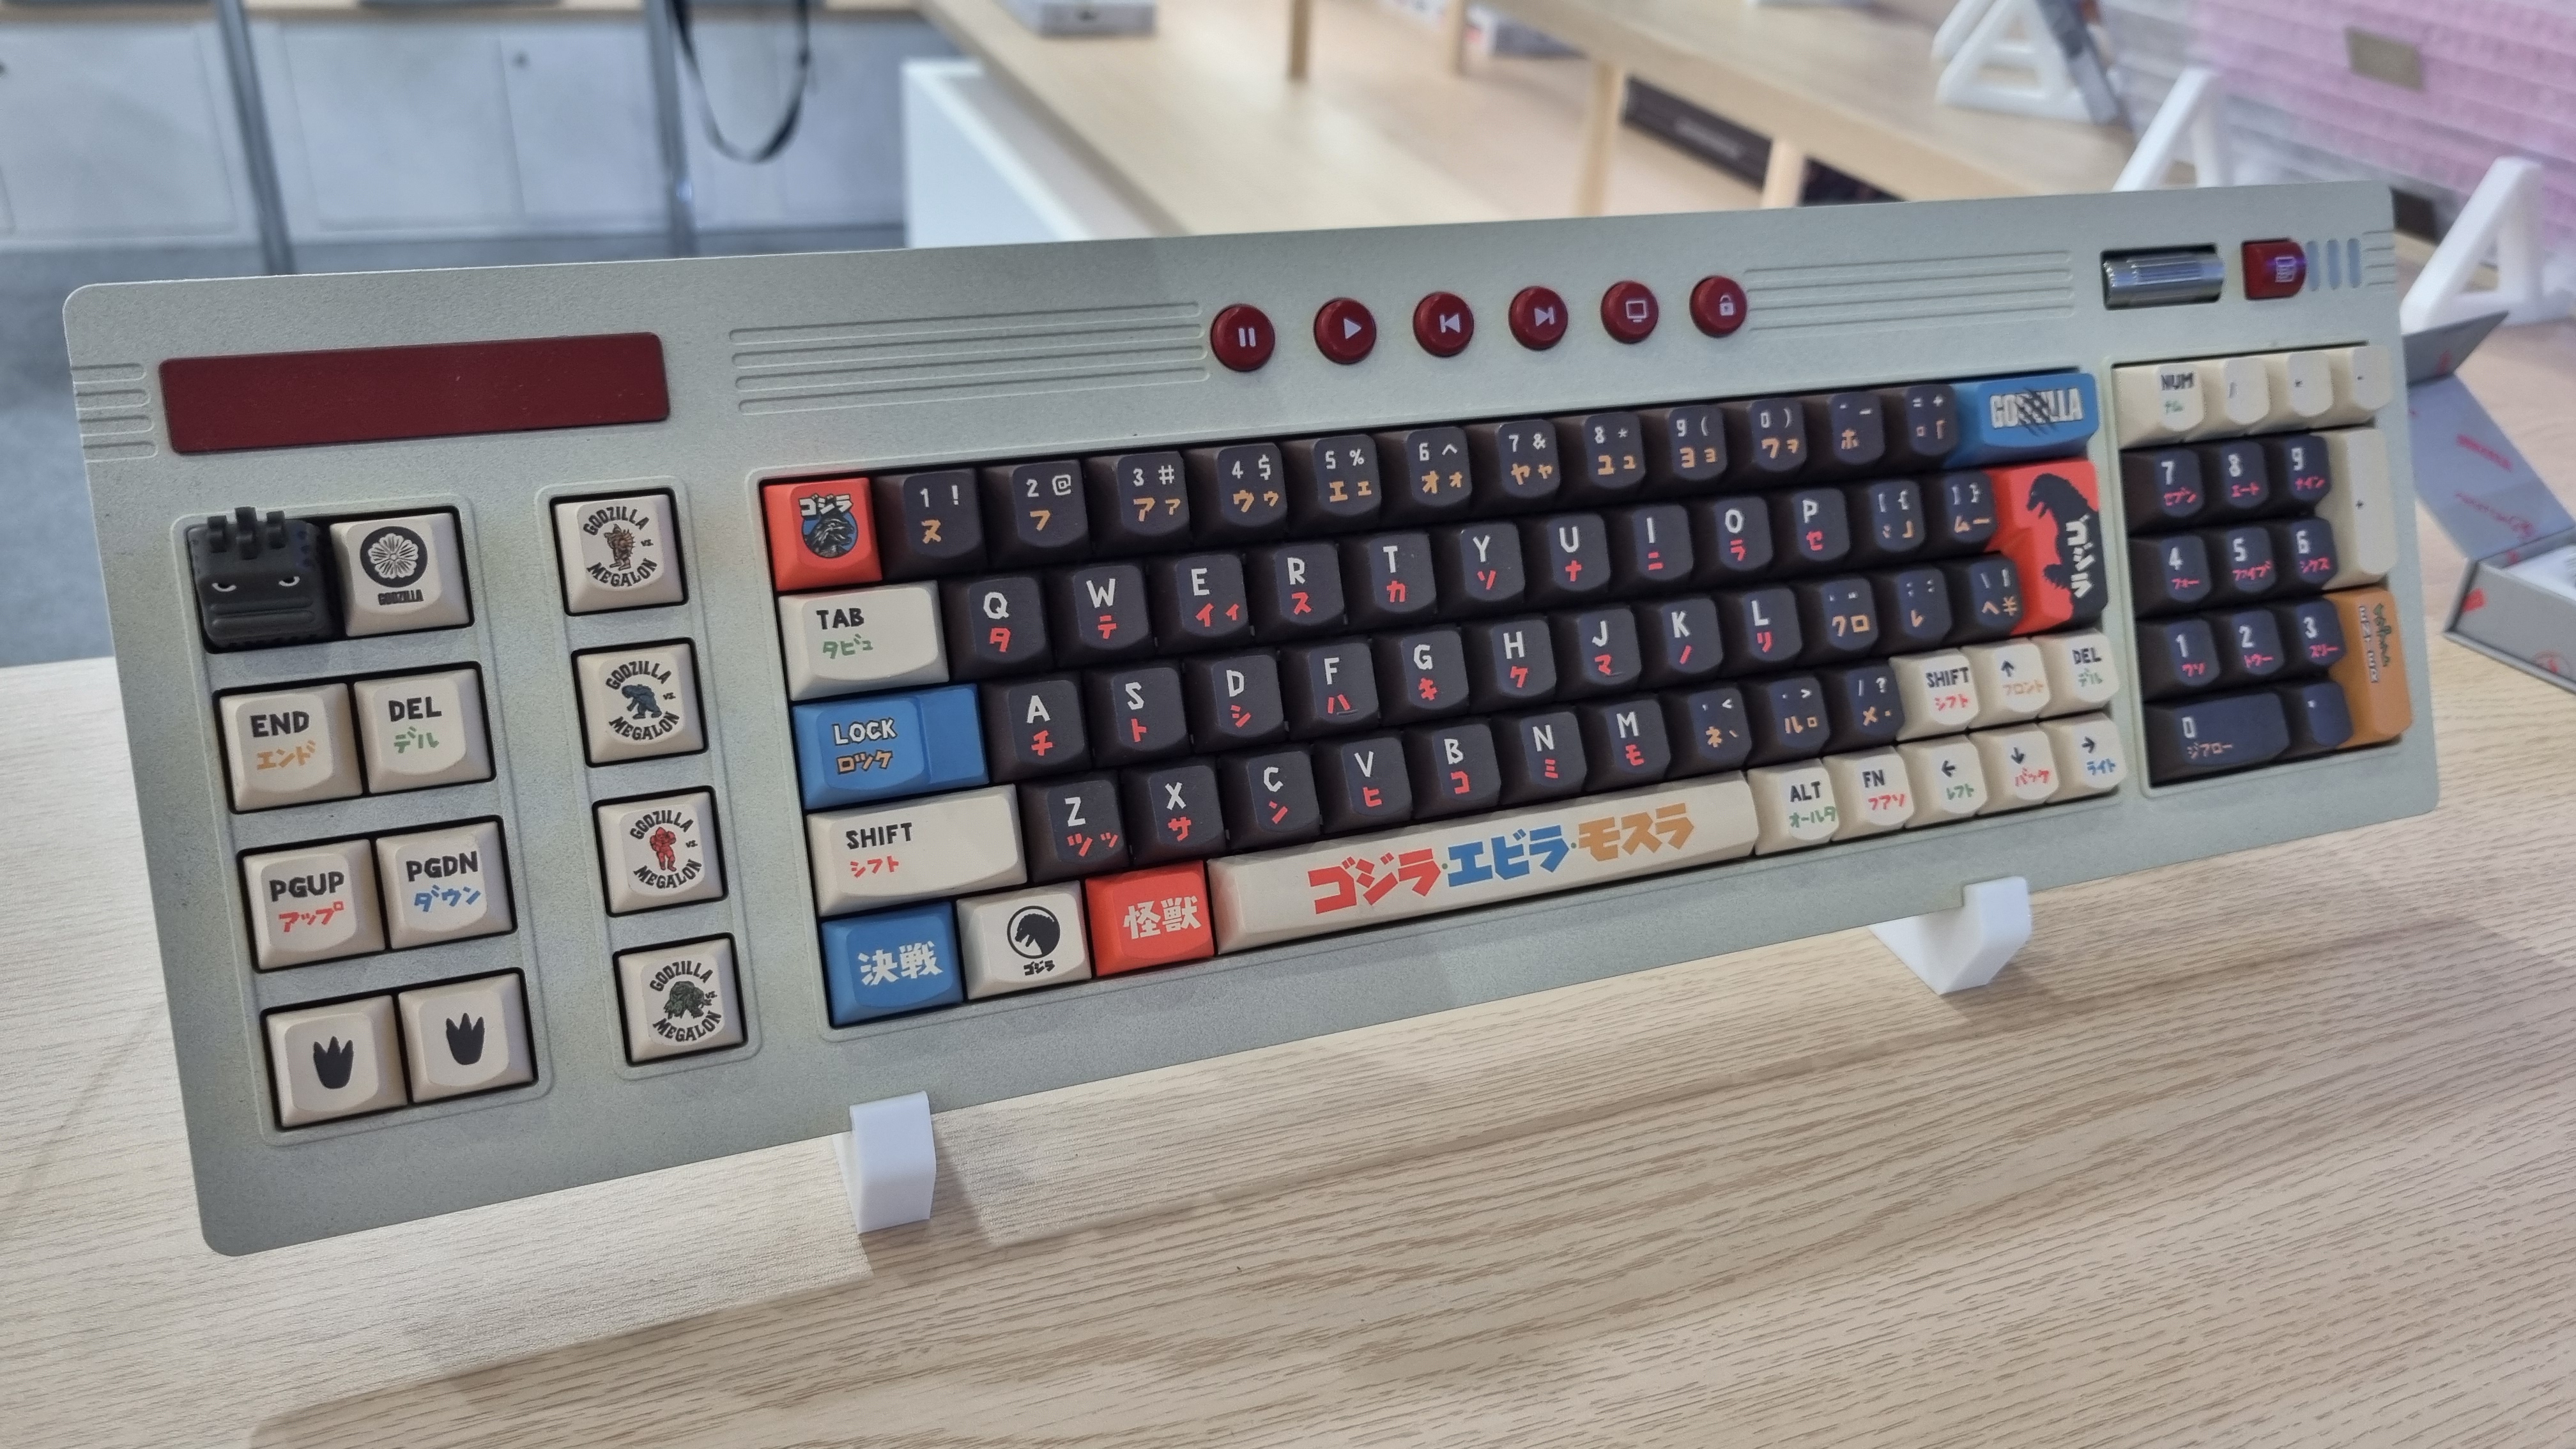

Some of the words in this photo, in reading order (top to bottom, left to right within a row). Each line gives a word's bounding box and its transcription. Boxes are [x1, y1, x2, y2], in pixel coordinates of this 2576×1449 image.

[2161, 372, 2195, 391] NUM
[1595, 426, 1605, 444] 8
[1676, 419, 1687, 437] 9
[1418, 443, 1429, 462] 6
[1508, 435, 1519, 452] 7
[1533, 433, 1546, 450] &
[1232, 461, 1243, 479] 4
[1258, 454, 1271, 480] $
[1325, 451, 1336, 470] 5
[1349, 448, 1365, 466] %
[2228, 453, 2242, 477] 8
[2291, 447, 2304, 471] 9
[1026, 479, 1039, 498] 2
[1052, 474, 1071, 496] @
[1133, 468, 1144, 486] 3
[1158, 464, 1175, 485] #
[2161, 461, 2175, 486] 7
[799, 493, 853, 516] ゴジラ
[919, 488, 930, 508] 1
[951, 485, 959, 505] !
[583, 506, 650, 537] GODZILLA
[1029, 510, 1051, 532] フ
[1802, 498, 1819, 523] P
[1472, 534, 1490, 563] Y
[1559, 526, 1579, 553] U
[1730, 539, 1746, 561] ラ
[2232, 537, 2248, 562] 5
[2296, 530, 2311, 555] 6
[1287, 557, 1305, 585] R
[1383, 546, 1398, 573] T
[2168, 546, 2184, 571] 4
[586, 558, 658, 587] MEGALON
[1191, 568, 1210, 596] E
[1086, 578, 1116, 608] W
[1291, 592, 1312, 615] ス
[1386, 581, 1406, 602] カ
[983, 591, 1009, 620] Q
[1751, 600, 1769, 627] L
[816, 608, 864, 630] TAB
[1097, 615, 1117, 639] テ
[1671, 611, 1690, 638] K
[2303, 615, 2319, 640] 3
[989, 627, 1011, 653] タ
[1503, 631, 1525, 660] H
[1591, 620, 1608, 647] J
[1757, 631, 1772, 653] リ
[2175, 633, 2189, 659] 1
[2239, 625, 2255, 648] 2
[1413, 644, 1434, 670] G
[2072, 647, 2102, 665] DEL
[606, 660, 671, 691] GODZILLA
[1226, 670, 1245, 698] D
[1324, 657, 1340, 685] F
[1925, 666, 1969, 688] SHIFT
[1125, 682, 1145, 710] S
[1418, 677, 1438, 702] キ
[1875, 677, 1887, 694] ?
[388, 696, 442, 722] DEL
[1026, 695, 1051, 724] A
[1327, 694, 1351, 714] ハ
[1935, 693, 1970, 712] シフト
[250, 710, 310, 738] END
[609, 710, 680, 741] MEGALON
[832, 718, 898, 746] LOCK
[1131, 718, 1147, 743] ト
[1616, 711, 1640, 739] M
[394, 726, 440, 754] デル
[1031, 730, 1054, 757] チ
[1444, 738, 1464, 765] B
[1533, 724, 1554, 753] N
[257, 740, 316, 770] エンド
[1354, 751, 1374, 778] V
[1625, 743, 1645, 766] モ
[2086, 758, 2117, 776] ライト
[1262, 766, 1284, 793] C
[1544, 758, 1559, 779] ミ
[1862, 769, 1886, 788] FN
[1450, 770, 1471, 795] コ
[1790, 780, 1821, 802] ALT
[1945, 783, 1975, 801] レフト
[1164, 781, 1187, 811] X
[1362, 786, 1383, 808] ヒ
[629, 809, 694, 840] GODZILLA
[1064, 796, 1087, 827] Z
[845, 822, 913, 850] SHIFT
[1167, 816, 1192, 842] サ
[406, 850, 478, 882] PGDN
[633, 859, 702, 889] MEGALON
[850, 855, 900, 878] シフト
[269, 871, 344, 901] PGUP
[413, 884, 481, 912] ダウン
[279, 900, 344, 932] アップ
[1123, 895, 1202, 939] 怪獣
[650, 960, 713, 992] GODZILLA
[857, 940, 944, 986] 決戦
[1023, 959, 1055, 976] ゴジラ
[652, 1010, 722, 1043] MEGALON
